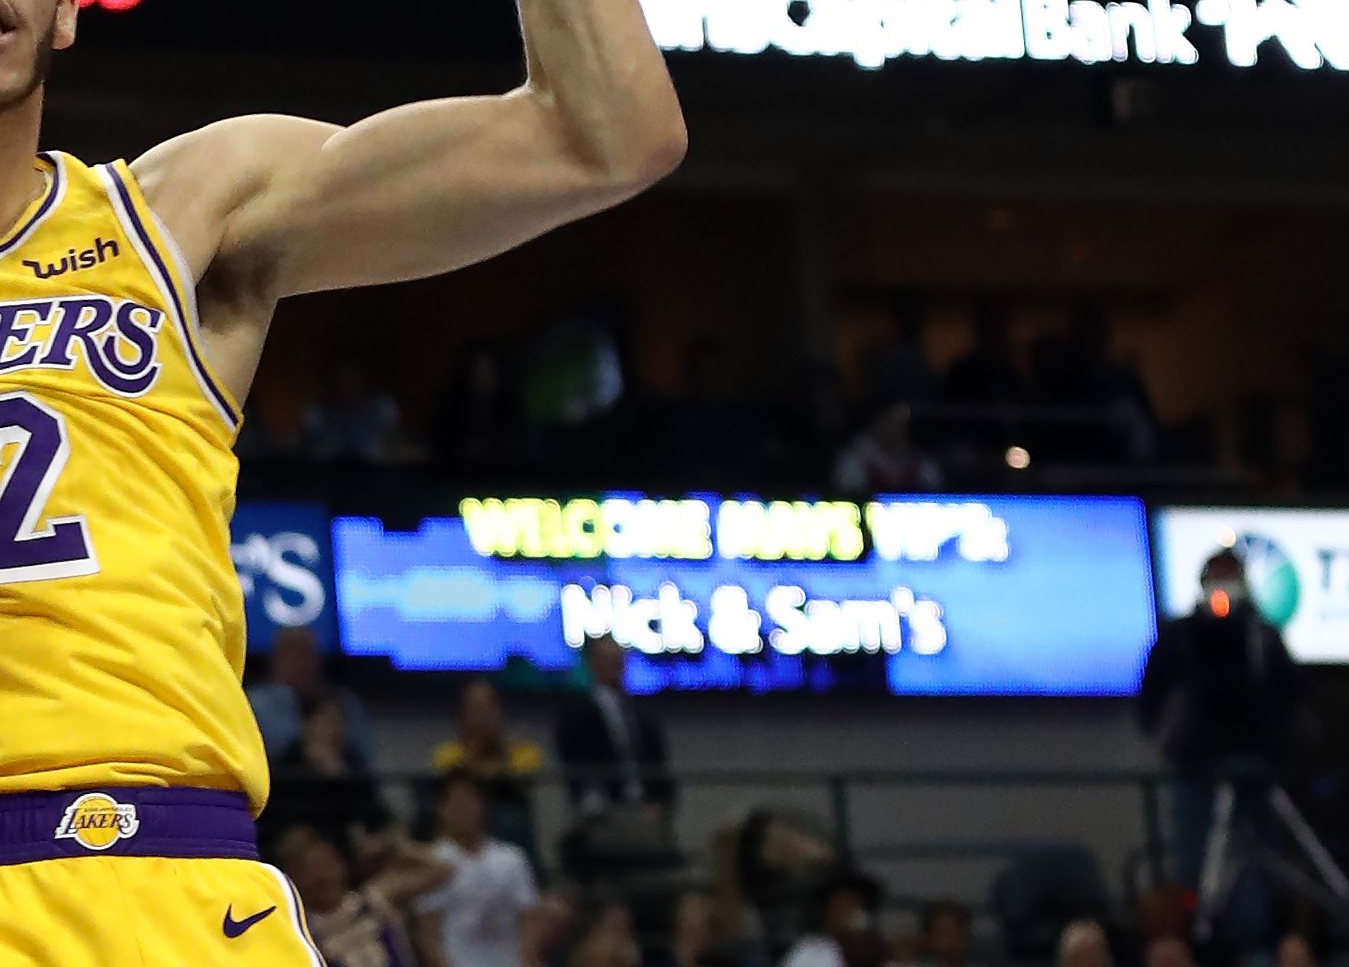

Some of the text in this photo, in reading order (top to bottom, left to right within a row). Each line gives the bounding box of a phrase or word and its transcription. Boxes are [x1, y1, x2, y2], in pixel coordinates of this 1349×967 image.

[22, 237, 120, 279] wish
[561, 581, 947, 655] Nick & Sam's
[59, 807, 135, 836] LAKERS
